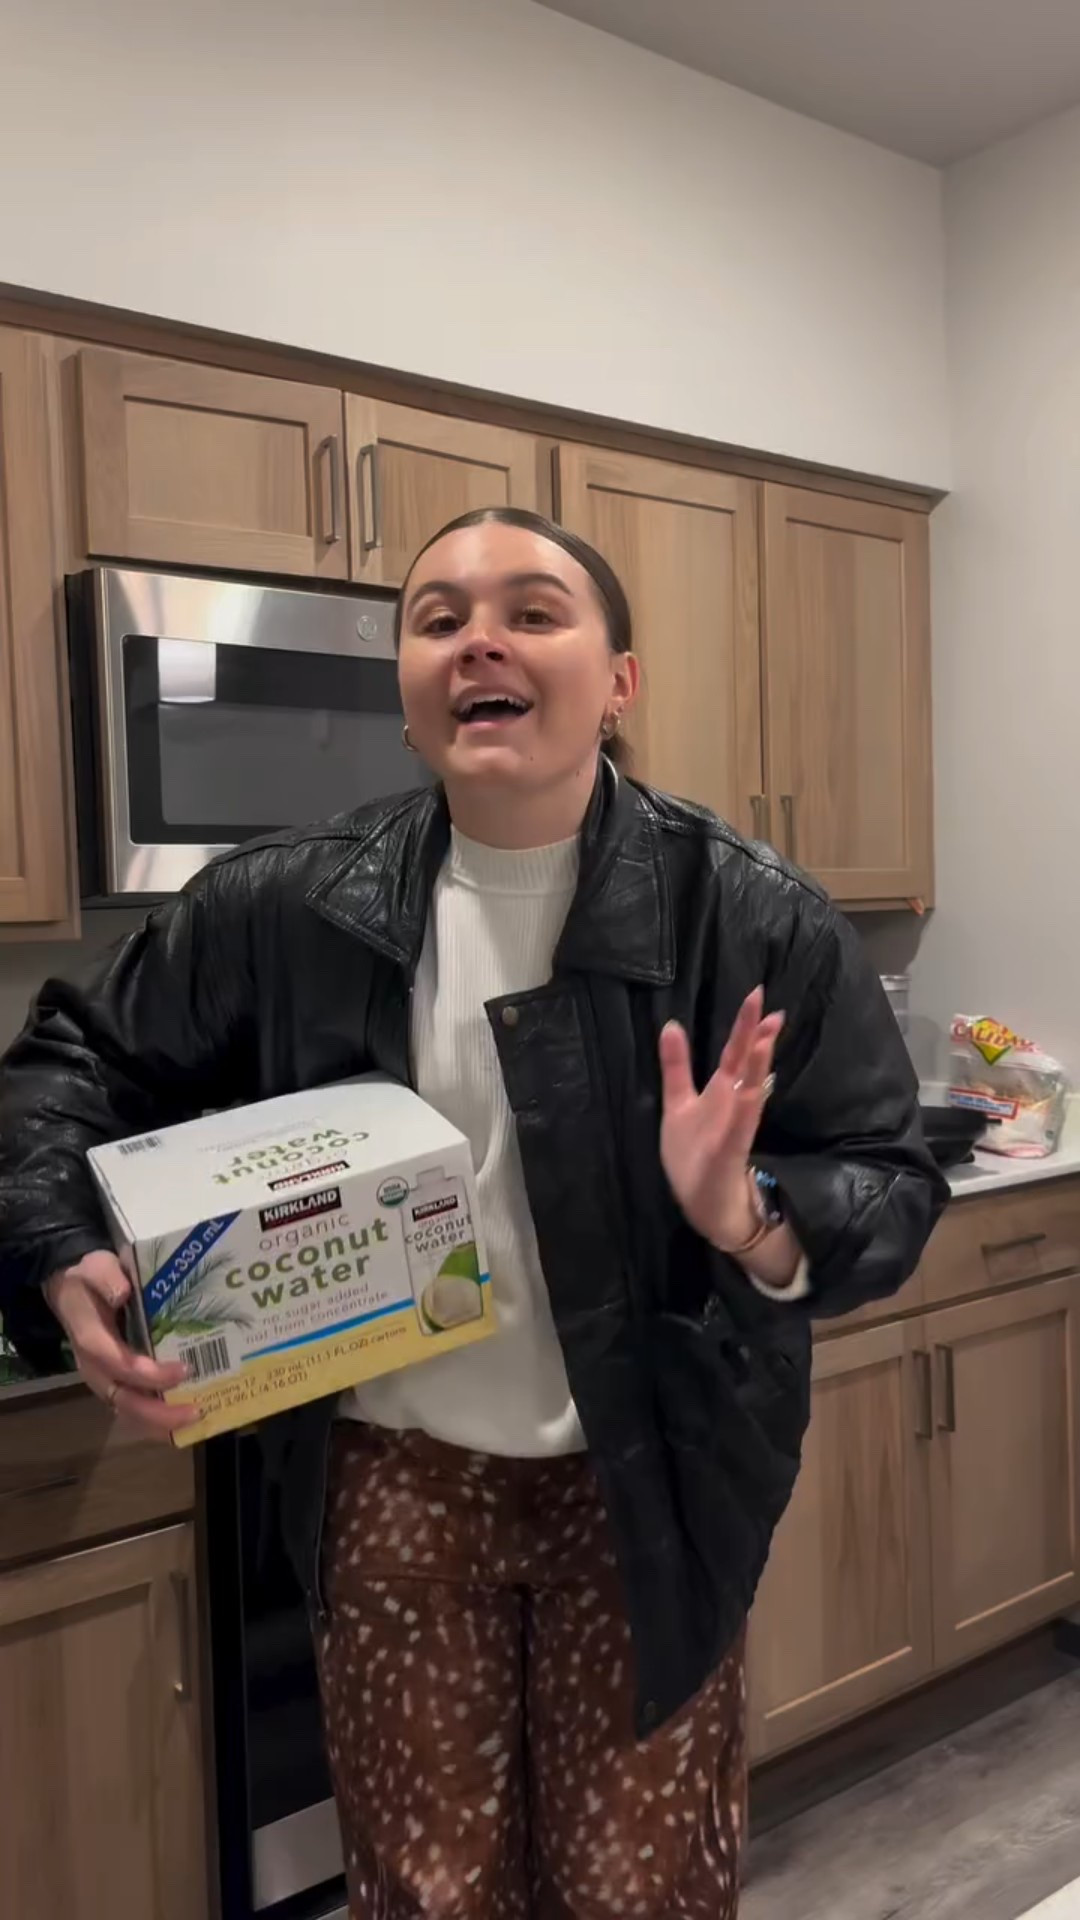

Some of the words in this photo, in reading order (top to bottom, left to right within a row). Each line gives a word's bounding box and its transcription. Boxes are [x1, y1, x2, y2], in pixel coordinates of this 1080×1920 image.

[212, 1131, 370, 1185] coconut
[229, 1128, 343, 1167] water
[263, 1189, 338, 1223] KIRKLAND
[258, 1212, 350, 1251] organic
[404, 1213, 472, 1245] coconut
[414, 1229, 465, 1253] water
[151, 1278, 171, 1300] 12
[175, 1240, 203, 1272] 330
[203, 1219, 225, 1243] mL
[225, 1217, 389, 1289] coconut
[251, 1253, 371, 1309] water
[263, 1315, 280, 1325] no
[285, 1301, 321, 1319] sugar
[327, 1282, 370, 1304] added
